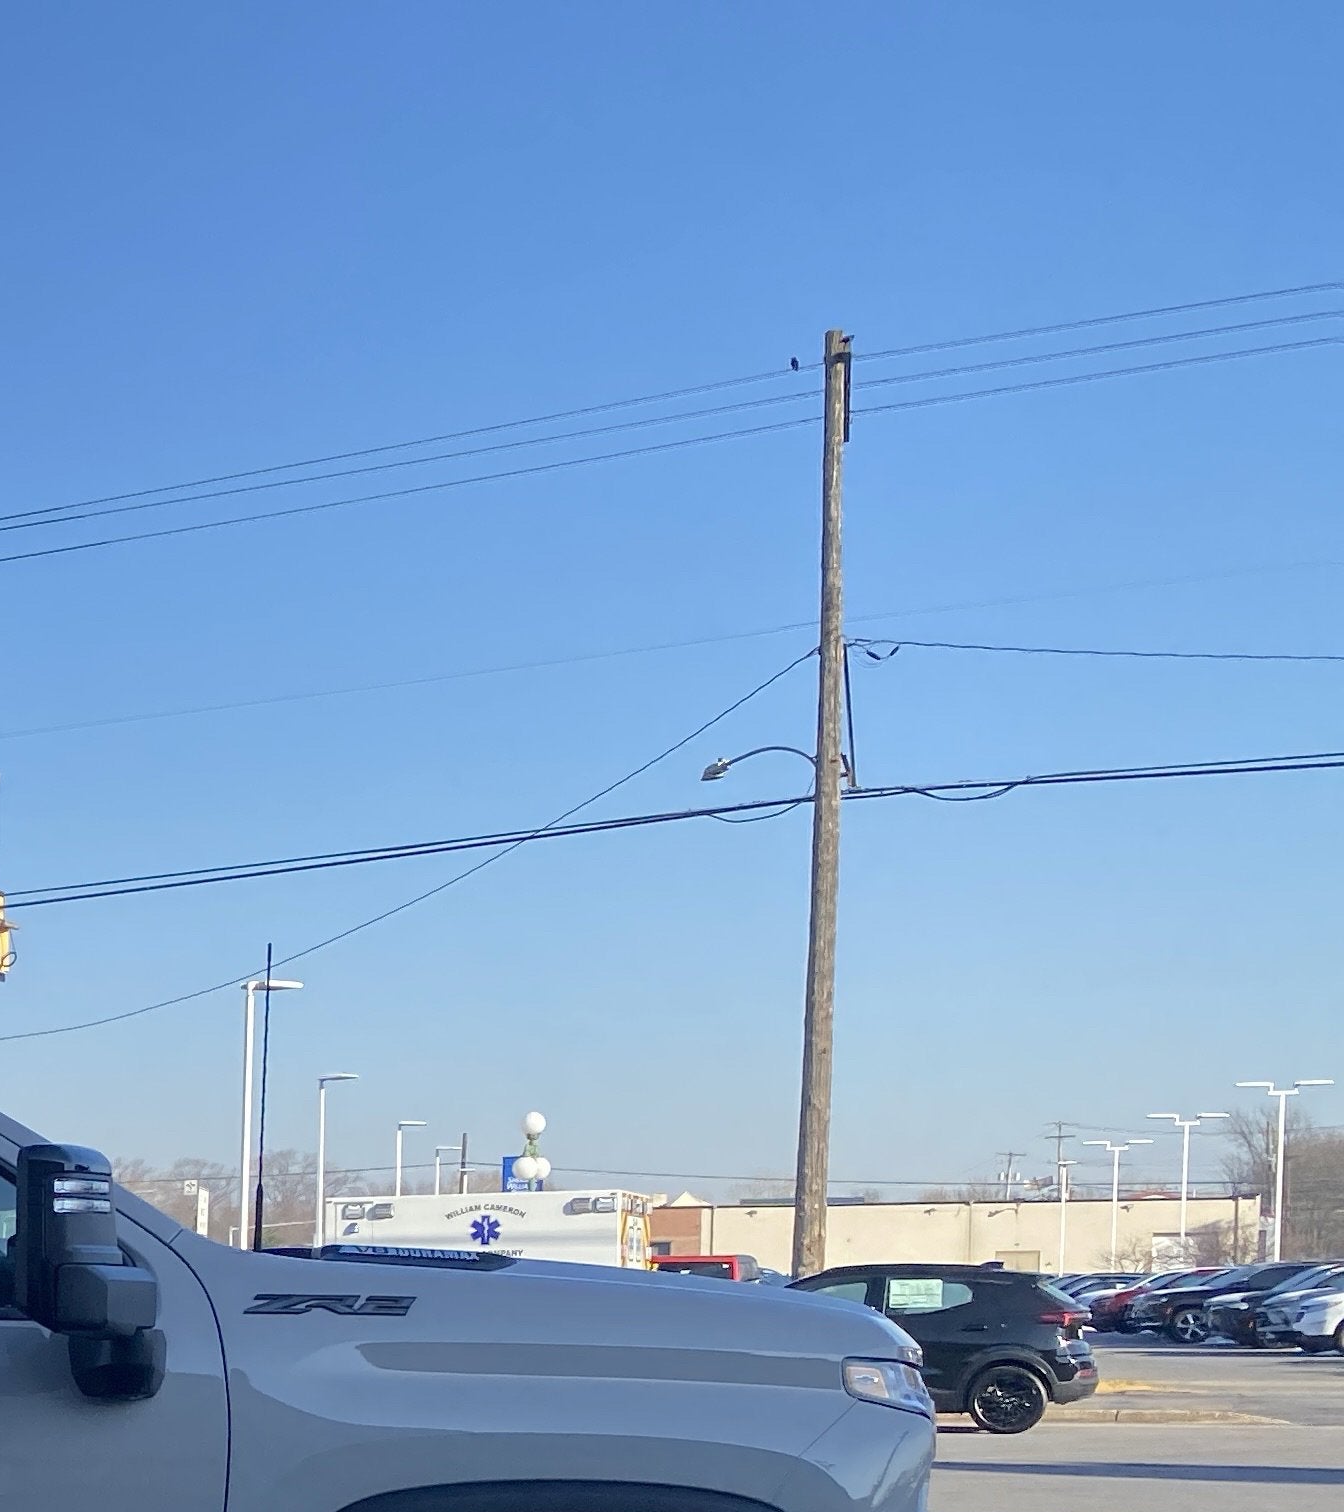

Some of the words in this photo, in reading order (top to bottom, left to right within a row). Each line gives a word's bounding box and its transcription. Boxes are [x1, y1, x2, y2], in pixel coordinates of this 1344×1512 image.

[445, 1204, 482, 1220] WILLIAM
[483, 1204, 527, 1219] CAMERON
[243, 1293, 418, 1317] ZR2
